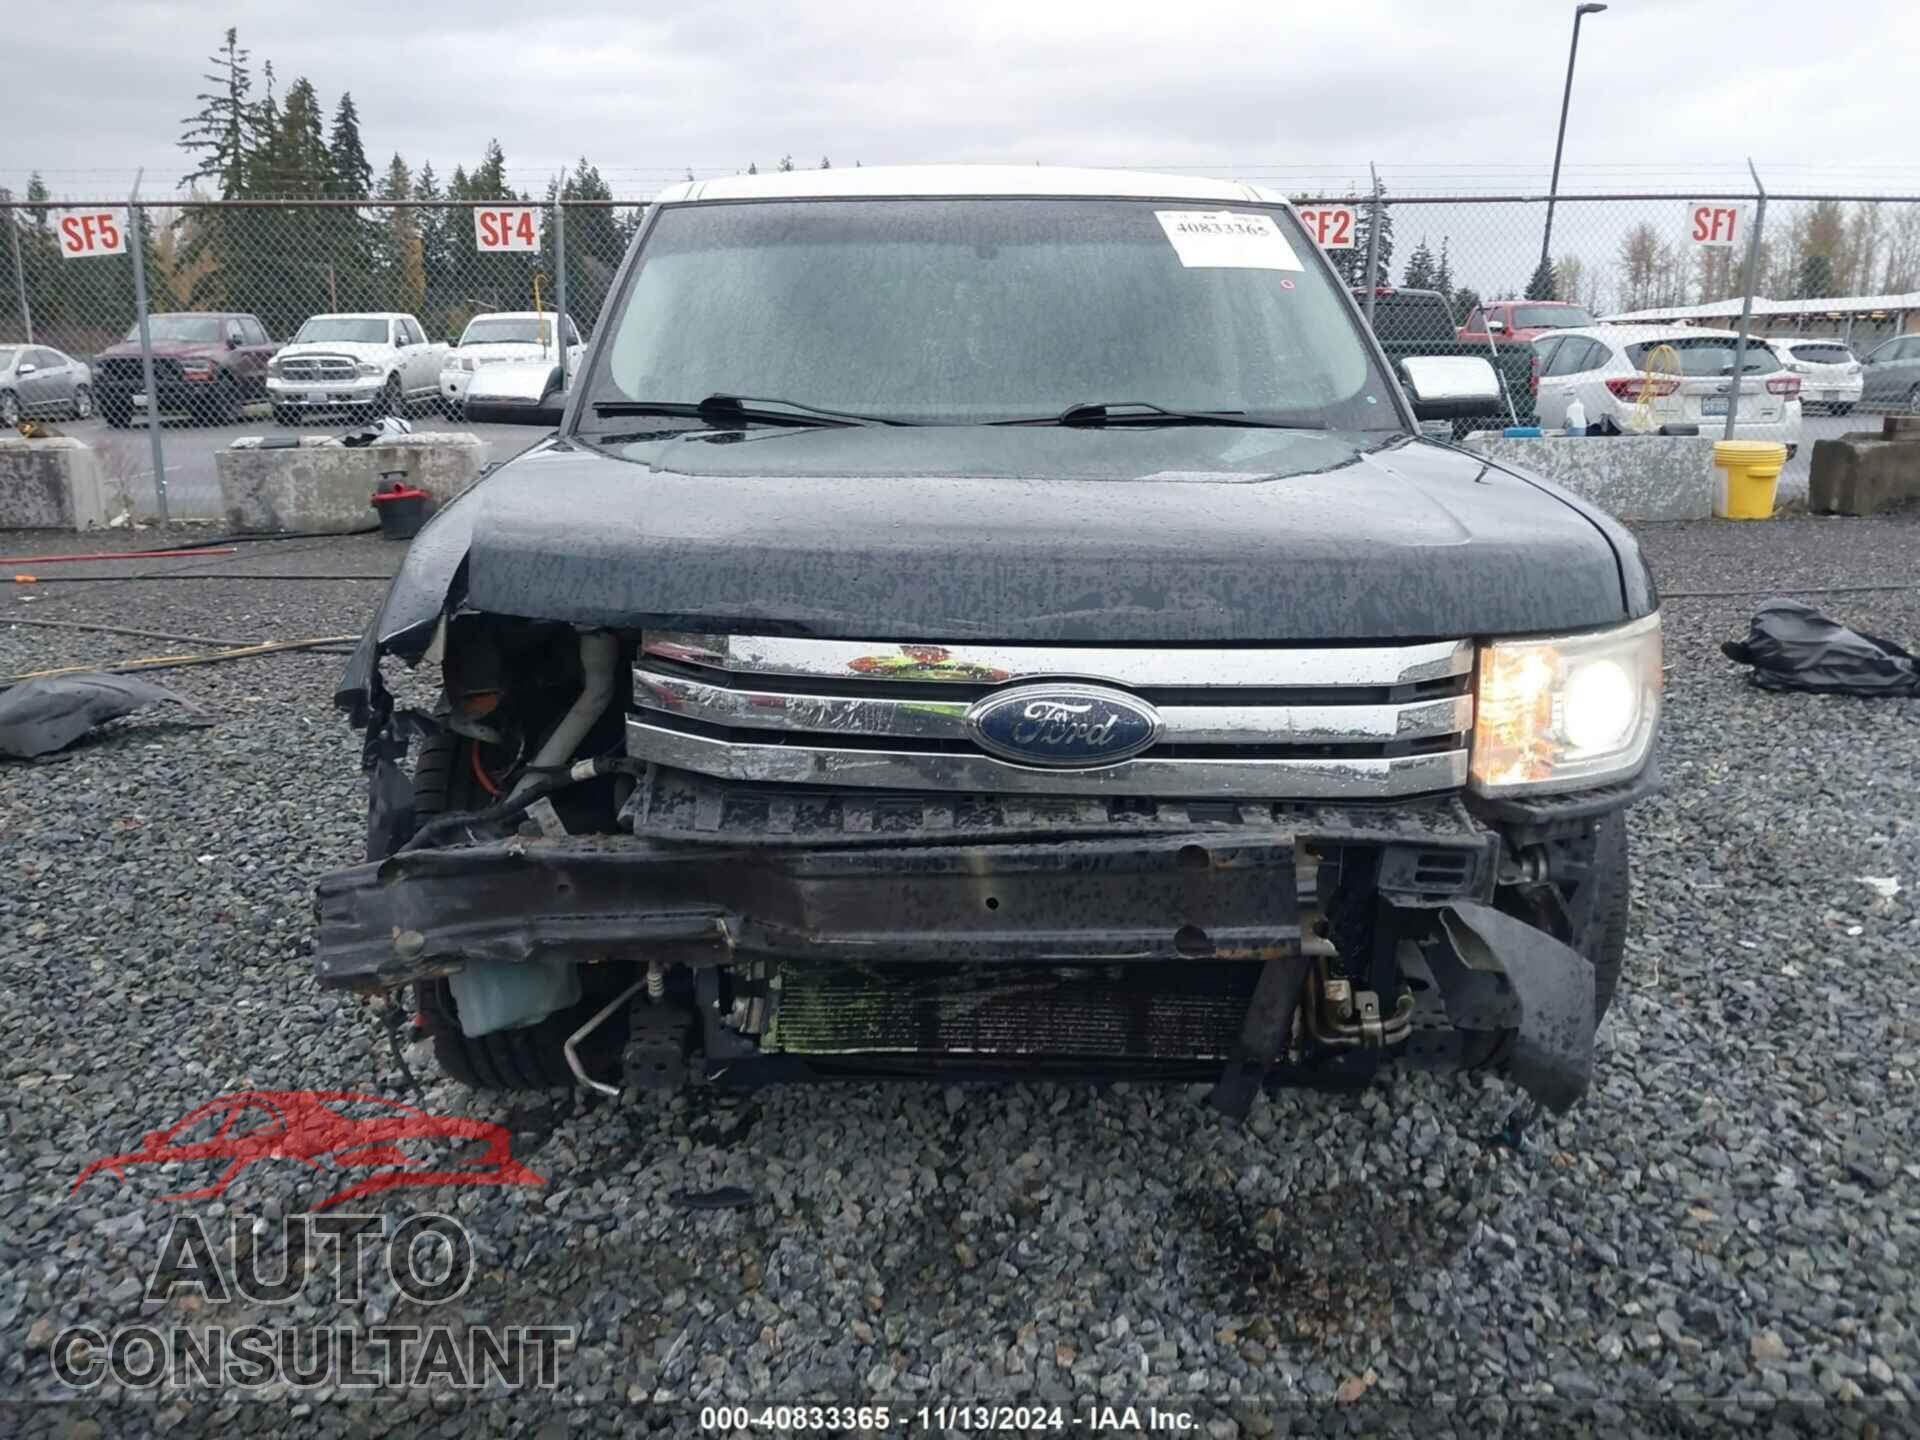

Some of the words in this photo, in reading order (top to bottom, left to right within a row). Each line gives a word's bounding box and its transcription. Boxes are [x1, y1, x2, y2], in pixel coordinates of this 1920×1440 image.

[62, 214, 119, 252] SF5
[480, 211, 535, 246] SF4
[1692, 207, 1737, 241] SF1
[1012, 700, 1120, 745] Ford
